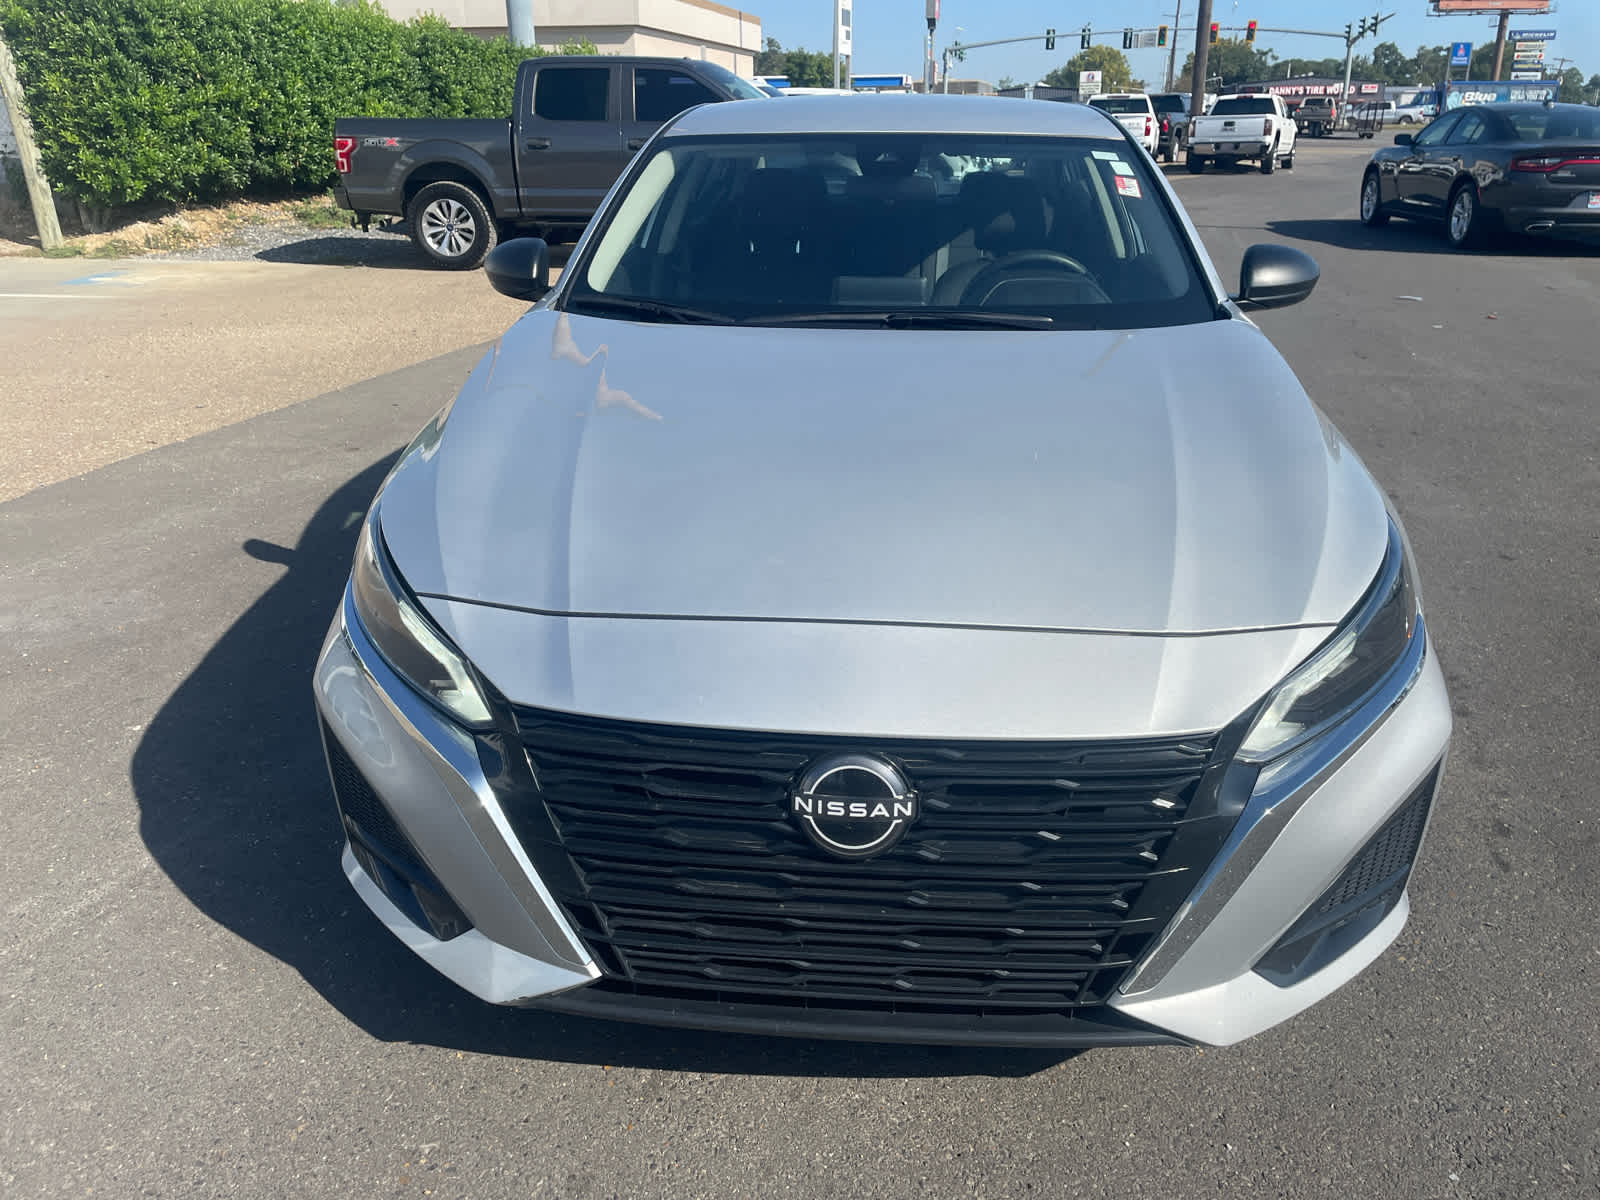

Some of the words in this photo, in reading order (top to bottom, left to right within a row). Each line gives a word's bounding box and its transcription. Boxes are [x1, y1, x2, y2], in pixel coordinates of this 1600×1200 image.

[1269, 85, 1304, 96] DANNY'S
[1305, 85, 1325, 95] TIRE
[1326, 84, 1356, 95] WOD
[794, 796, 912, 818] NISSAN
